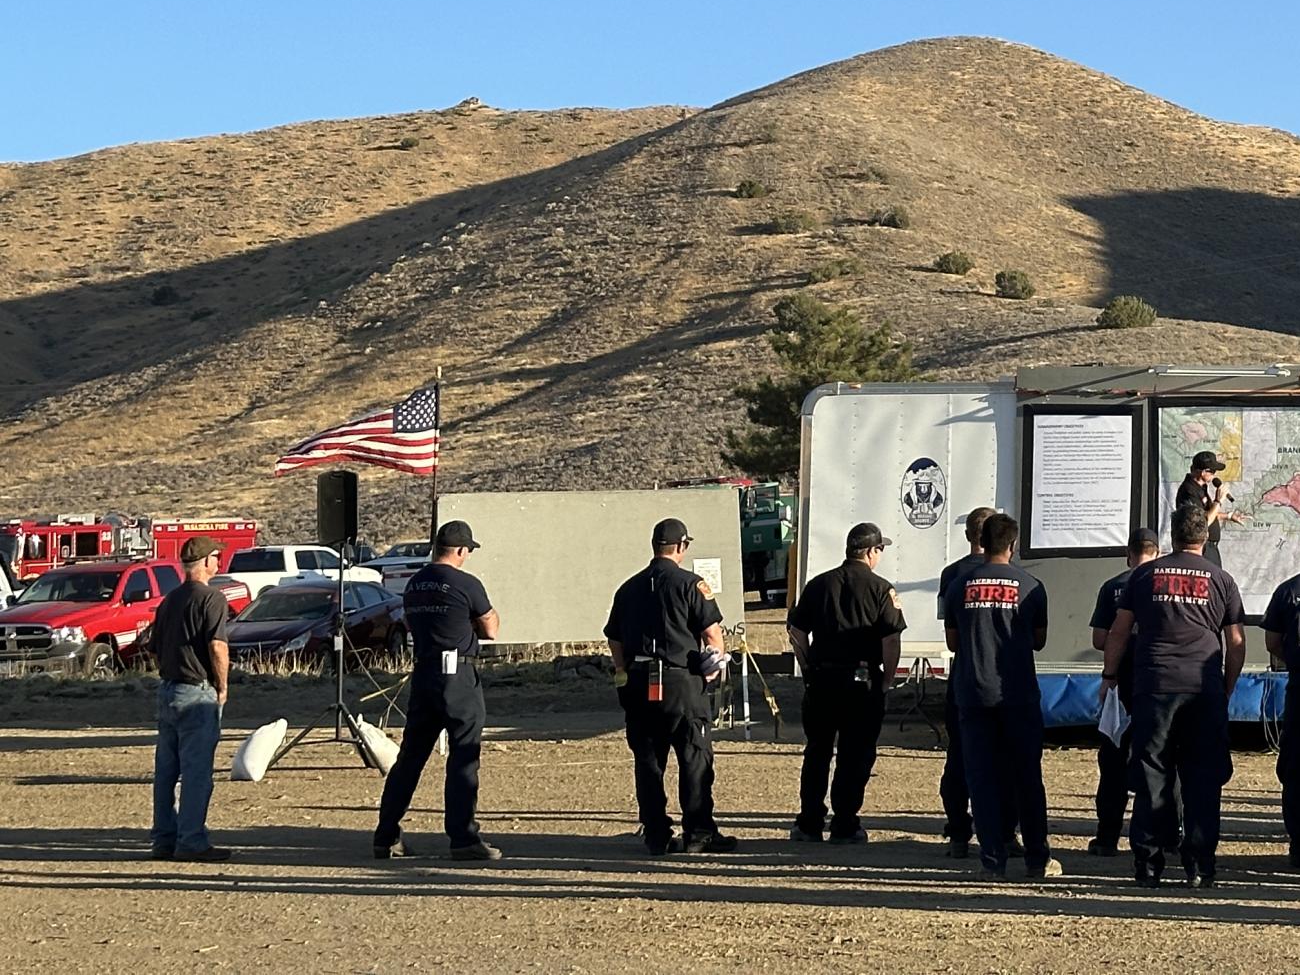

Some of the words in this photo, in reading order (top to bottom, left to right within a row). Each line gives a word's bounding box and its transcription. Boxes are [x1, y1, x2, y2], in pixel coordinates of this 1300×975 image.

[1154, 568, 1212, 578] BAKERSFIELD
[966, 578, 1019, 587] BAKERSFIELD
[1153, 575, 1209, 597] FIRE
[964, 585, 1018, 602] FIRE
[1152, 594, 1209, 606] DEPARTMENT
